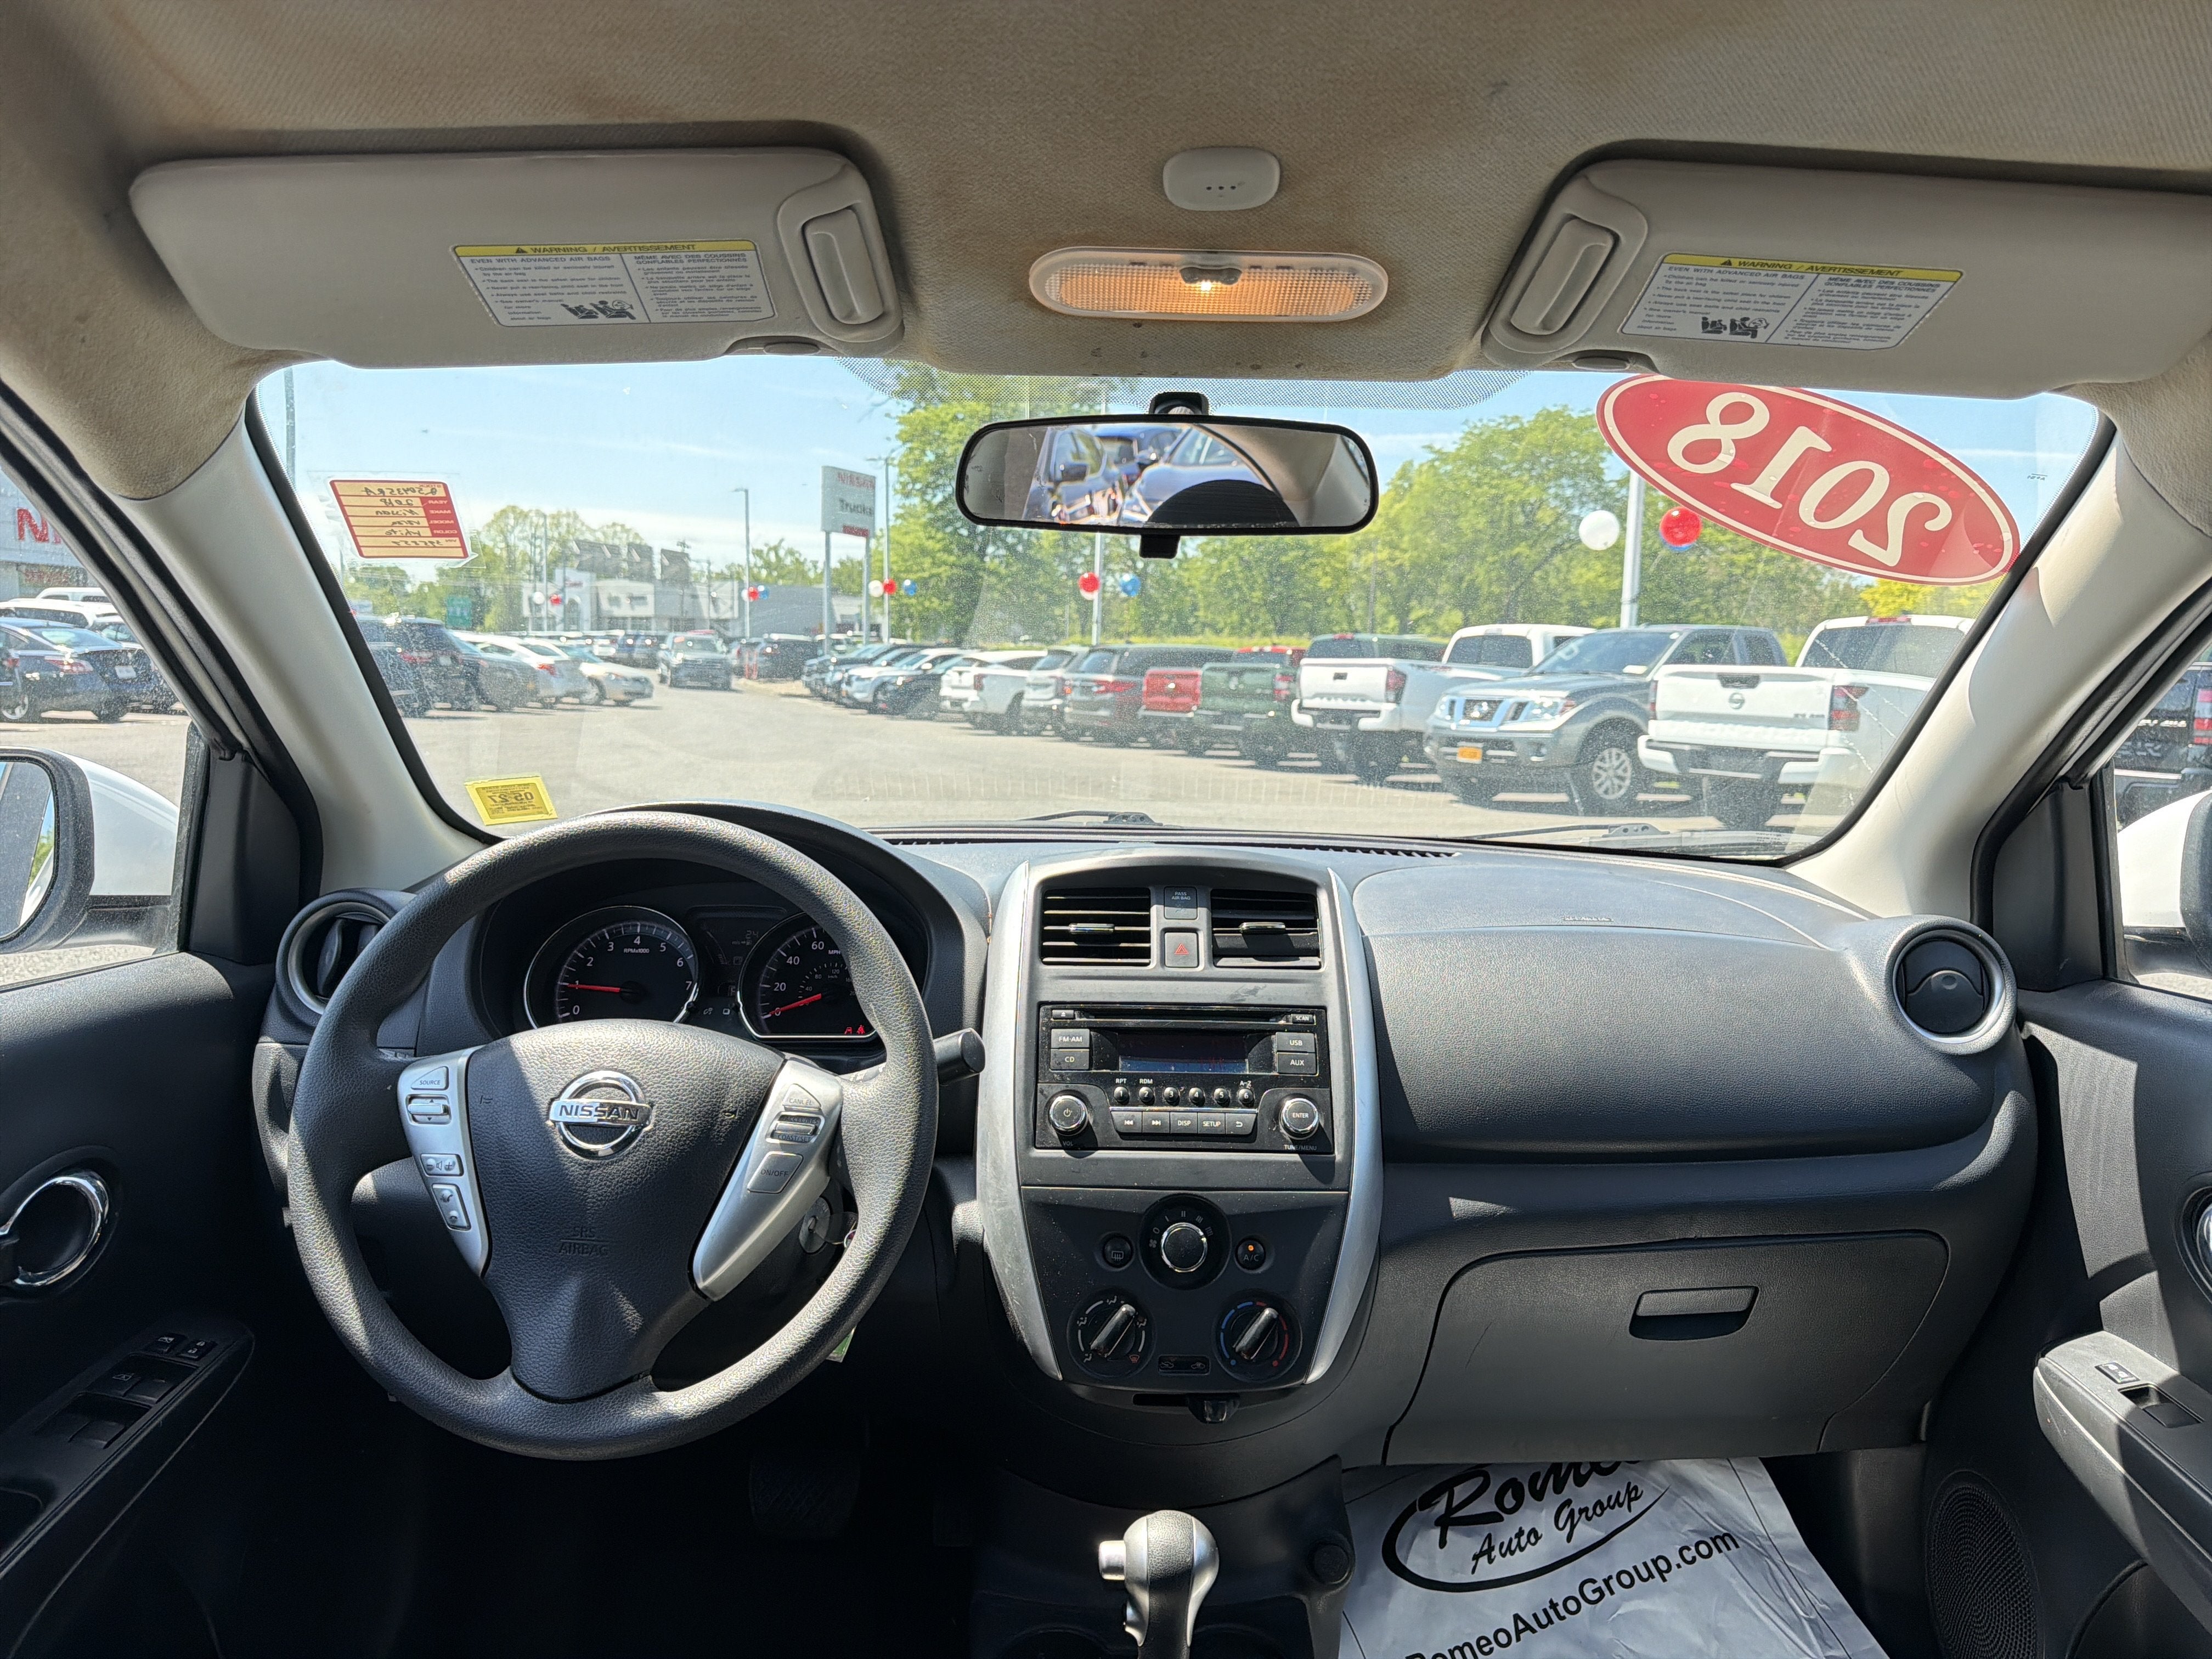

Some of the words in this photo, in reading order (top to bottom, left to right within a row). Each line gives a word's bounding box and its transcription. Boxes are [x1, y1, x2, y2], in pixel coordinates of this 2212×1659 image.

[602, 244, 696, 252] AVERTISSEMENT
[1739, 261, 1792, 269] WARNING
[1805, 266, 1903, 276] AVERTISSEMENT
[634, 936, 641, 945] 4
[607, 942, 614, 951] 3
[659, 943, 666, 951] 5
[811, 941, 824, 950] 60
[586, 957, 594, 966] 2
[676, 958, 684, 967] 6
[786, 956, 799, 965] 40
[686, 981, 692, 990] 7
[774, 982, 786, 991] 20
[573, 1005, 580, 1015] 0
[789, 1098, 812, 1106] CANCEL
[558, 1104, 640, 1121] NISSAN
[777, 1134, 811, 1142] COAST/SET
[760, 1169, 789, 1177] ON/OFF
[1243, 1254, 1259, 1262] A/C
[1471, 1526, 1542, 1575] Auto
[1554, 1481, 1644, 1543] Group
